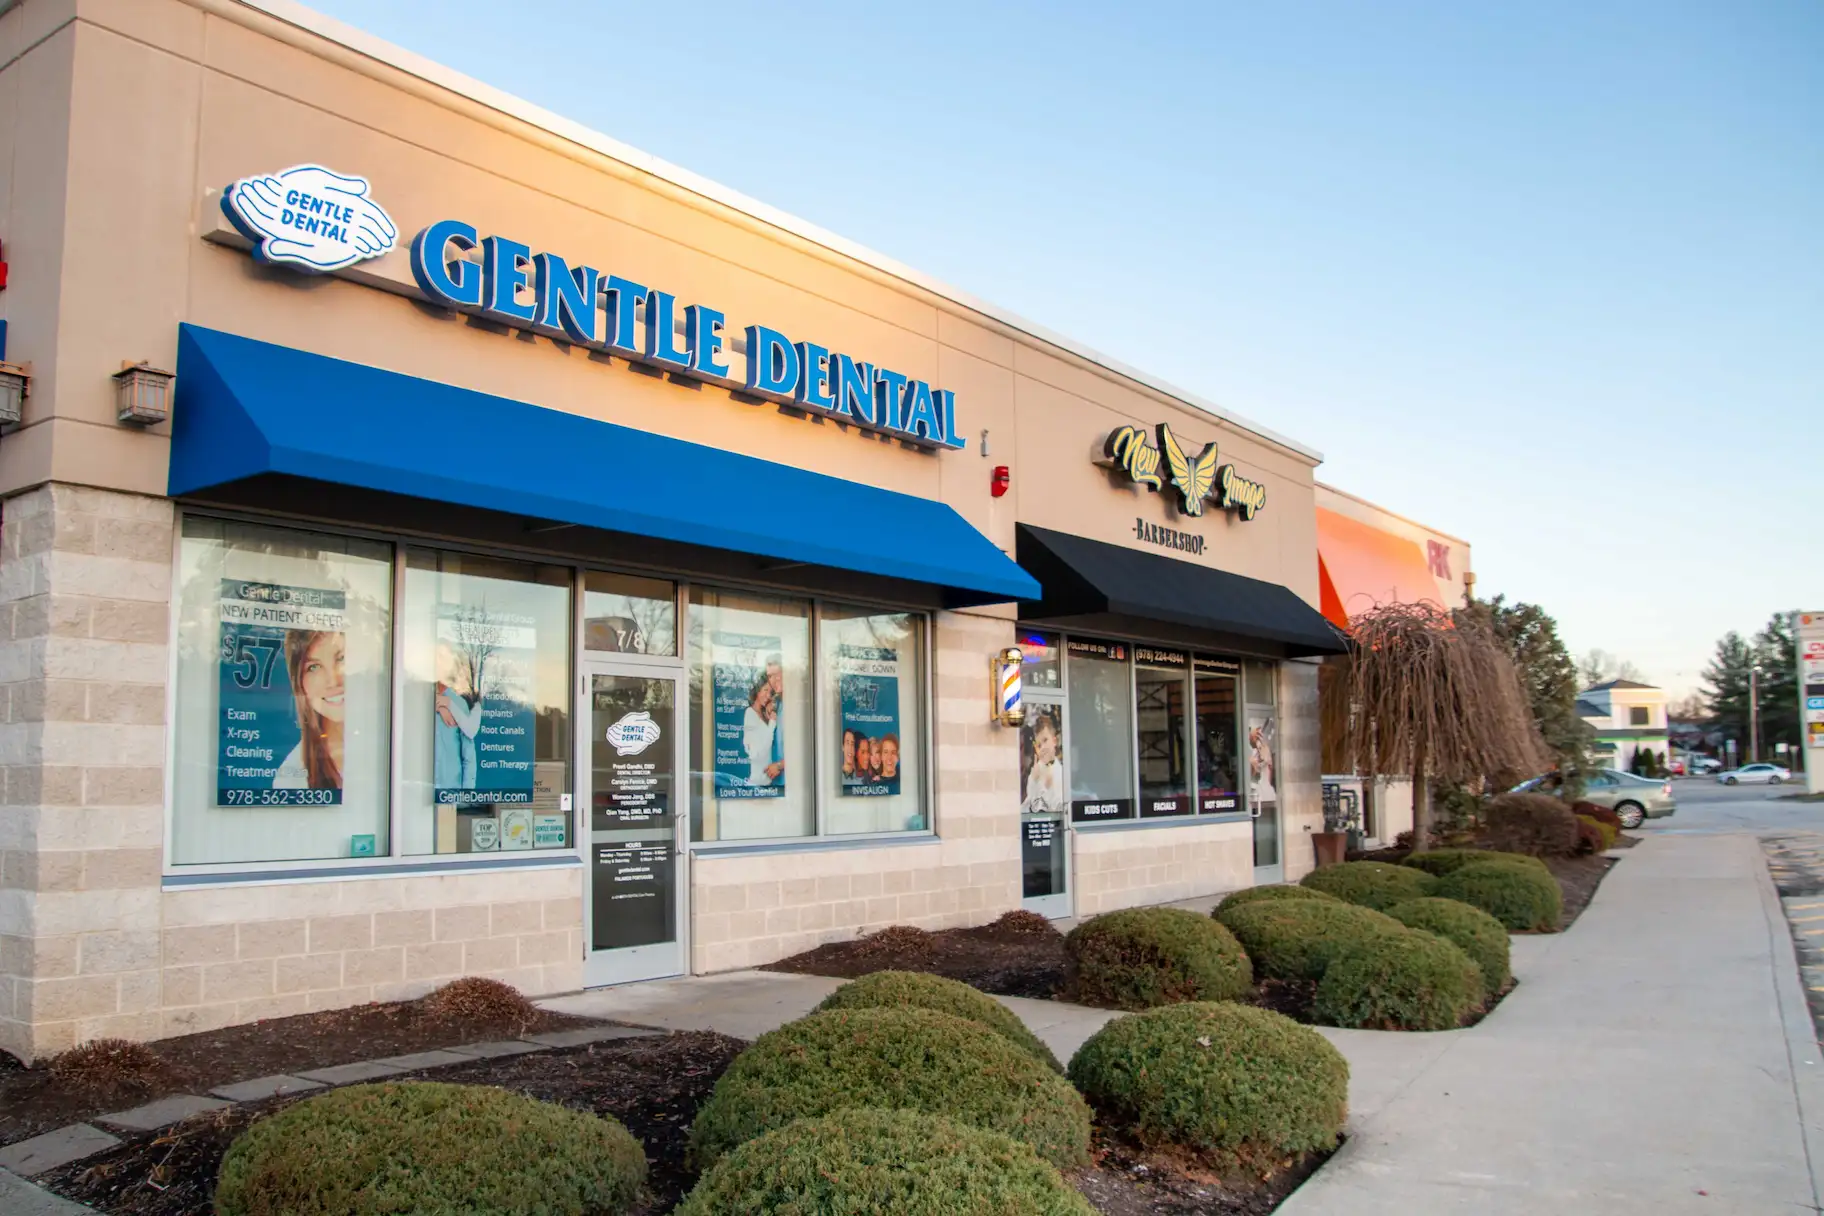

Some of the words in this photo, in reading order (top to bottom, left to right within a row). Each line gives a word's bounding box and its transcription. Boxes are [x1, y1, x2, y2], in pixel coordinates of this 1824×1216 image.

[286, 189, 354, 224] GENTLE
[281, 208, 348, 244] DENTAL
[411, 219, 730, 379] GENTLE
[745, 323, 966, 450] DENTAL
[1107, 425, 1162, 492] New
[1219, 464, 1266, 521] Image
[239, 583, 280, 601] Gentle
[283, 589, 325, 605] Dental
[221, 604, 249, 619] NEW
[253, 608, 301, 624] PATIENT
[305, 612, 344, 628] OFFER
[222, 634, 284, 689] $57
[1135, 649, 1154, 662] (978)
[1154, 651, 1185, 664] 224-4944
[227, 708, 257, 721] Exam
[481, 709, 513, 719] Implants
[227, 727, 260, 743] X-rays
[481, 726, 498, 734] Root
[500, 726, 525, 735] Canals
[622, 725, 645, 733] GENTLE
[621, 734, 644, 742] DENTAL
[226, 746, 273, 761] Cleaning
[481, 743, 515, 752] Dentures
[226, 765, 282, 778] Treatmen
[480, 760, 498, 769] Gum
[499, 760, 529, 771] Therapy
[439, 791, 528, 803] GentleDental.com
[719, 788, 736, 797] Love
[737, 787, 753, 797] Your
[753, 787, 778, 797] Dentist
[852, 785, 889, 796] INVISALIGN
[226, 790, 333, 805] 978-562-3330
[1204, 800, 1216, 809] HOT
[1215, 799, 1235, 808] SHAVES
[1084, 805, 1100, 815] KIDS
[1100, 804, 1119, 814] CUTS
[1153, 801, 1177, 811] FACIALS
